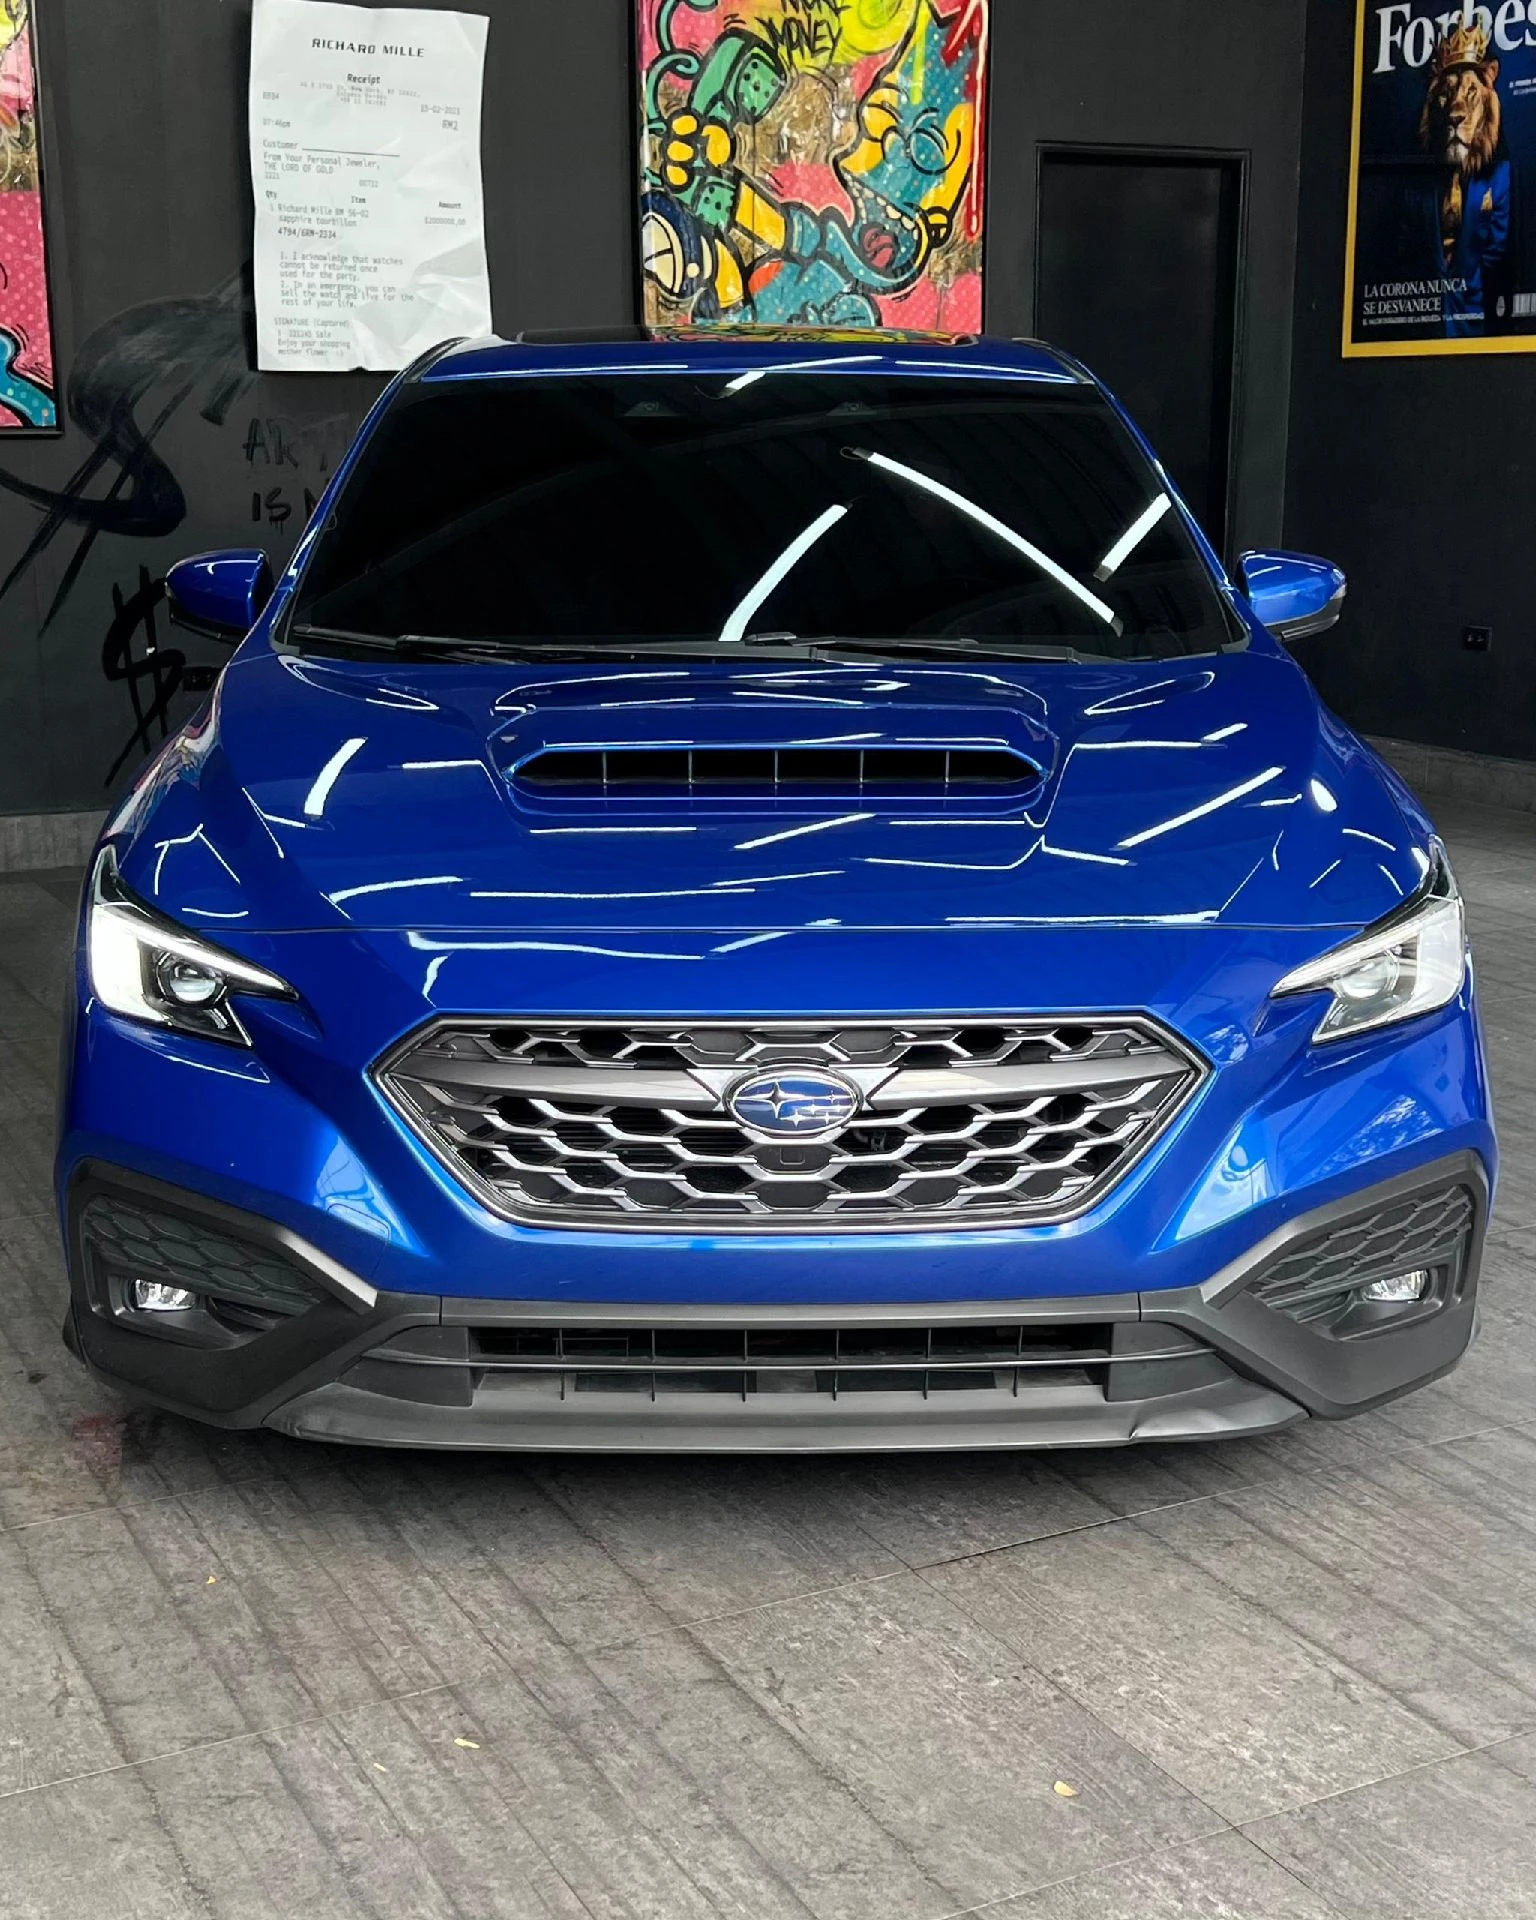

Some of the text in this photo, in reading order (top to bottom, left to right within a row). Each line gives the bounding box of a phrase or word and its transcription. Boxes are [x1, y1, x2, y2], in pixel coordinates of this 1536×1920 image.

[311, 38, 424, 57] RICHARD MILLE
[754, 16, 843, 73] MONEY
[346, 73, 381, 85] Receipt
[262, 139, 299, 149] Customer
[263, 152, 281, 161] From
[285, 153, 302, 162] Your
[307, 155, 342, 166] Personal
[264, 161, 334, 175] THE LORD OF GOLD
[278, 203, 308, 213] Richard
[302, 252, 348, 264] acknowledge
[352, 254, 368, 264] that
[372, 256, 403, 265] watches
[279, 261, 306, 269] cannot
[310, 261, 320, 269] be
[323, 262, 357, 272] returned
[302, 270, 314, 278] for
[320, 271, 333, 279] the
[1364, 278, 1468, 298] LA CORONA NUNCA
[281, 298, 299, 306] rest
[316, 300, 333, 309] your
[1363, 297, 1441, 315] SE DESVANECE
[252, 487, 291, 523] IS
